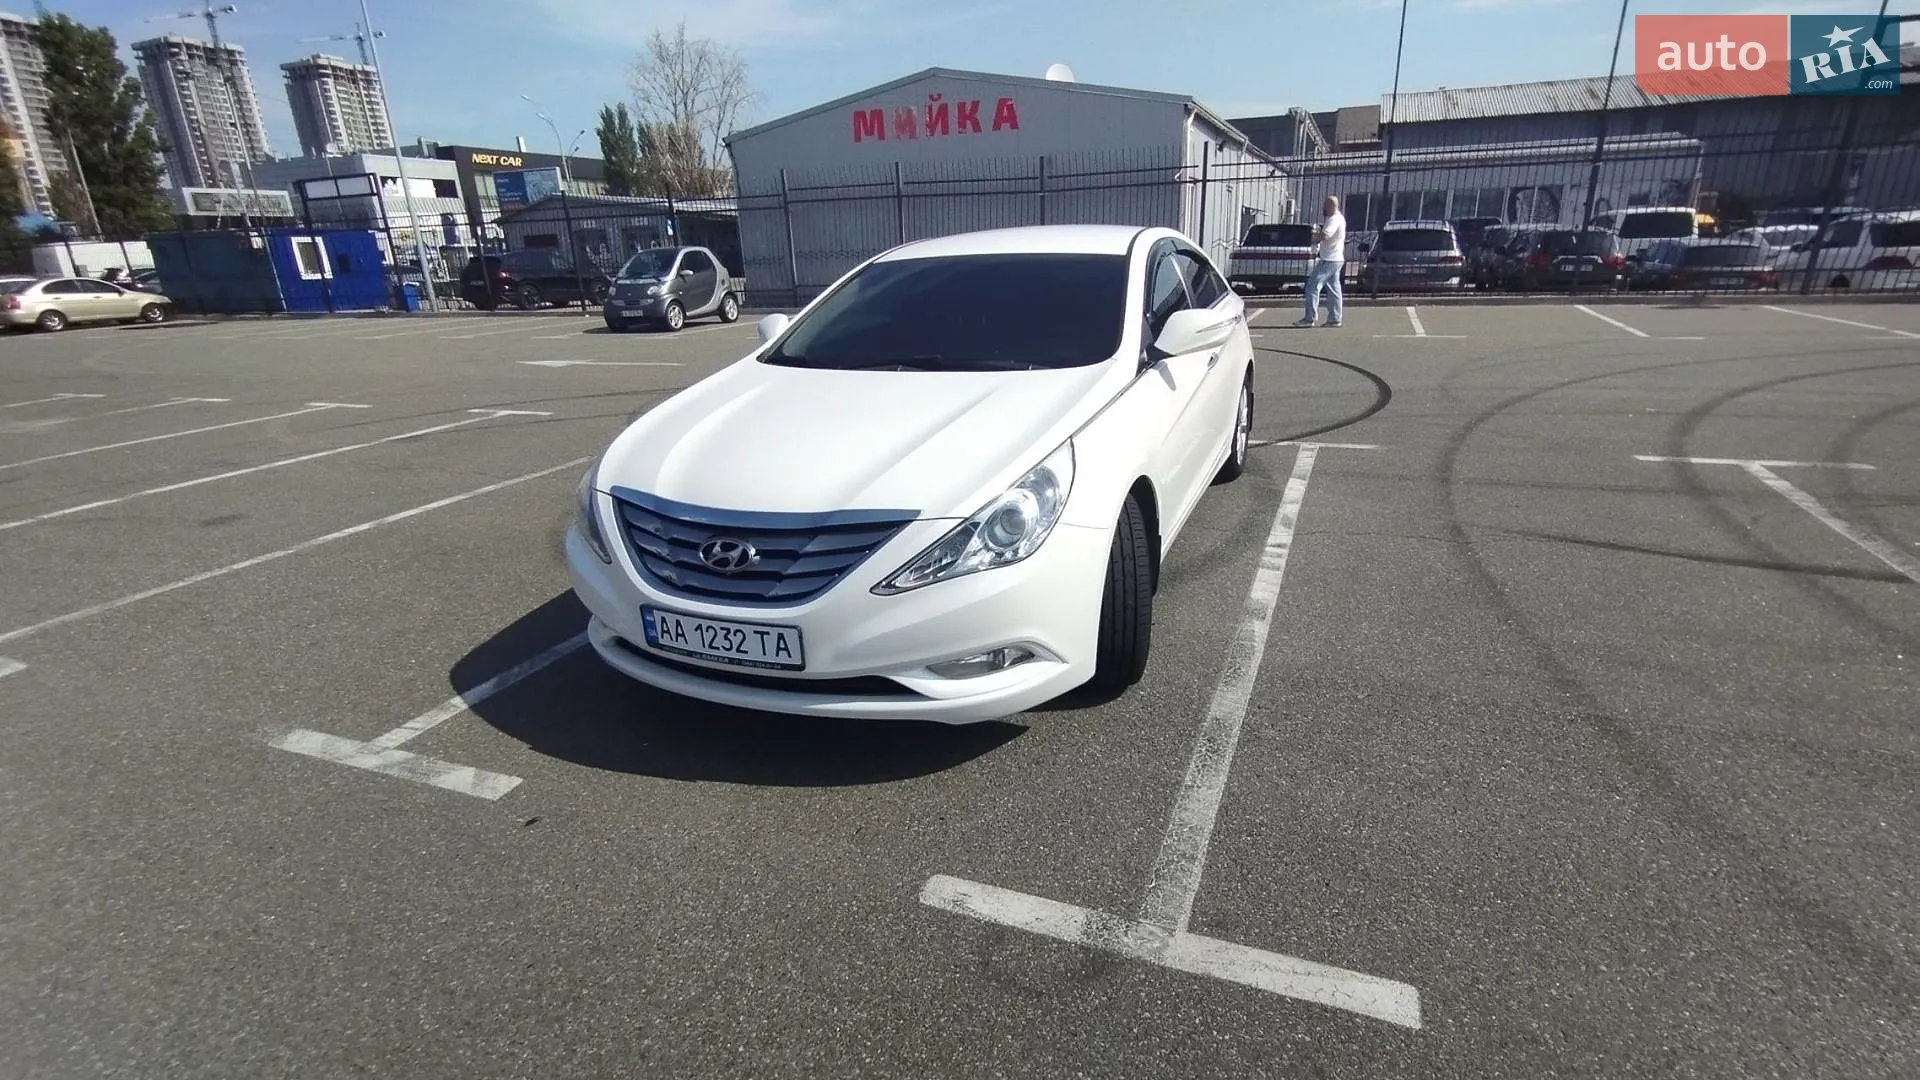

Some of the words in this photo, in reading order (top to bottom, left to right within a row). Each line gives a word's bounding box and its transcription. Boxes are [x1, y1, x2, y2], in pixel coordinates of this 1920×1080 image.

[853, 93, 1020, 143] МИЙКА
[500, 156, 523, 167] CAR
[660, 615, 689, 645] AA
[694, 623, 749, 654] 1232
[753, 630, 793, 659] TA
